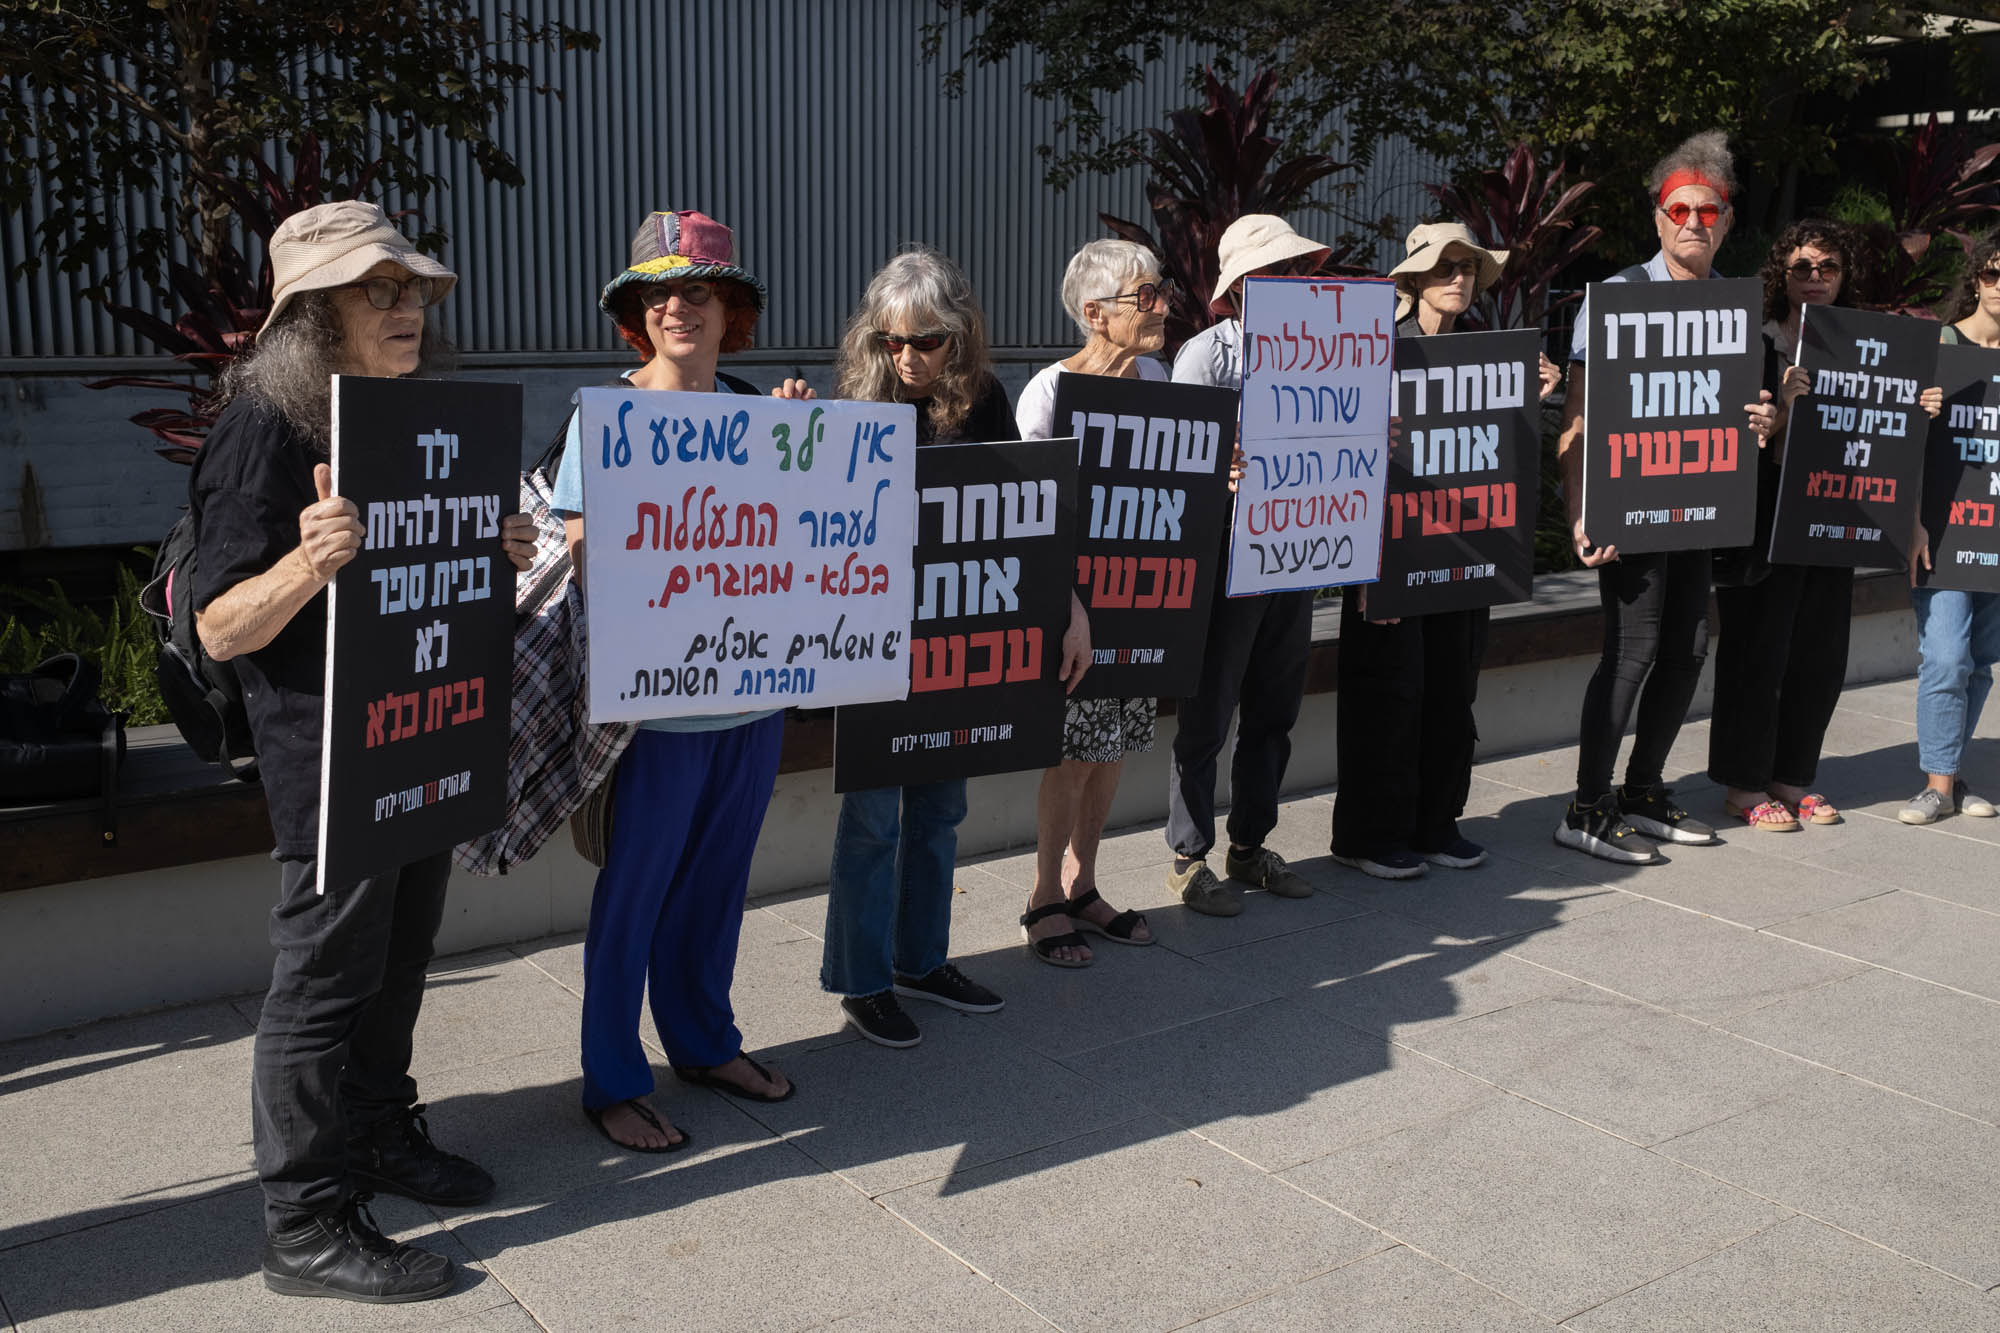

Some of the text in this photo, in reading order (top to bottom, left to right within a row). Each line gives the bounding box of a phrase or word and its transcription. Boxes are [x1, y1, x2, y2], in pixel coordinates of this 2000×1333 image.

[1310, 285, 1344, 323] די
[1604, 308, 1747, 360] שחררו
[1856, 338, 1887, 366] ילד
[1271, 384, 1360, 424] שחררו
[1630, 369, 1720, 419] אותו
[1814, 369, 1917, 405] צריך להיות
[601, 400, 896, 482] אין ילד שמגיע לו
[1817, 405, 1907, 437] בבית ספר
[417, 428, 459, 479] ילד
[1251, 448, 1377, 491] את הנער
[1411, 424, 1499, 477] אותו
[1608, 427, 1738, 478] עכשיו
[1843, 439, 1871, 467] לא
[1953, 437, 1999, 463] ספר
[1806, 470, 1896, 503] בבית כלא
[364, 493, 500, 550] צריך להיות
[625, 478, 890, 551] לעבור התעללות
[1089, 485, 1186, 541] אותו
[1248, 490, 1367, 536] האוטיסט
[1390, 482, 1516, 539] עכשיו
[1626, 510, 1645, 525] ילדים
[1647, 509, 1669, 524] מעצרי
[1684, 507, 1704, 521] הורים
[1949, 499, 1994, 527] כלא
[1249, 535, 1352, 575] ממעצר
[1956, 550, 1975, 564] ילדים
[371, 556, 490, 615] בבית ספר
[912, 557, 1020, 621] אות
[1076, 556, 1197, 609] עכשי
[415, 620, 448, 672] לא
[684, 613, 901, 664] יש משטרים אפלים
[734, 667, 816, 696] וחברות
[365, 677, 485, 748] בבית כלא
[892, 734, 917, 753] ילדים
[920, 731, 950, 749] מעצרי
[971, 726, 997, 743] הורים
[375, 793, 396, 822] ילדים
